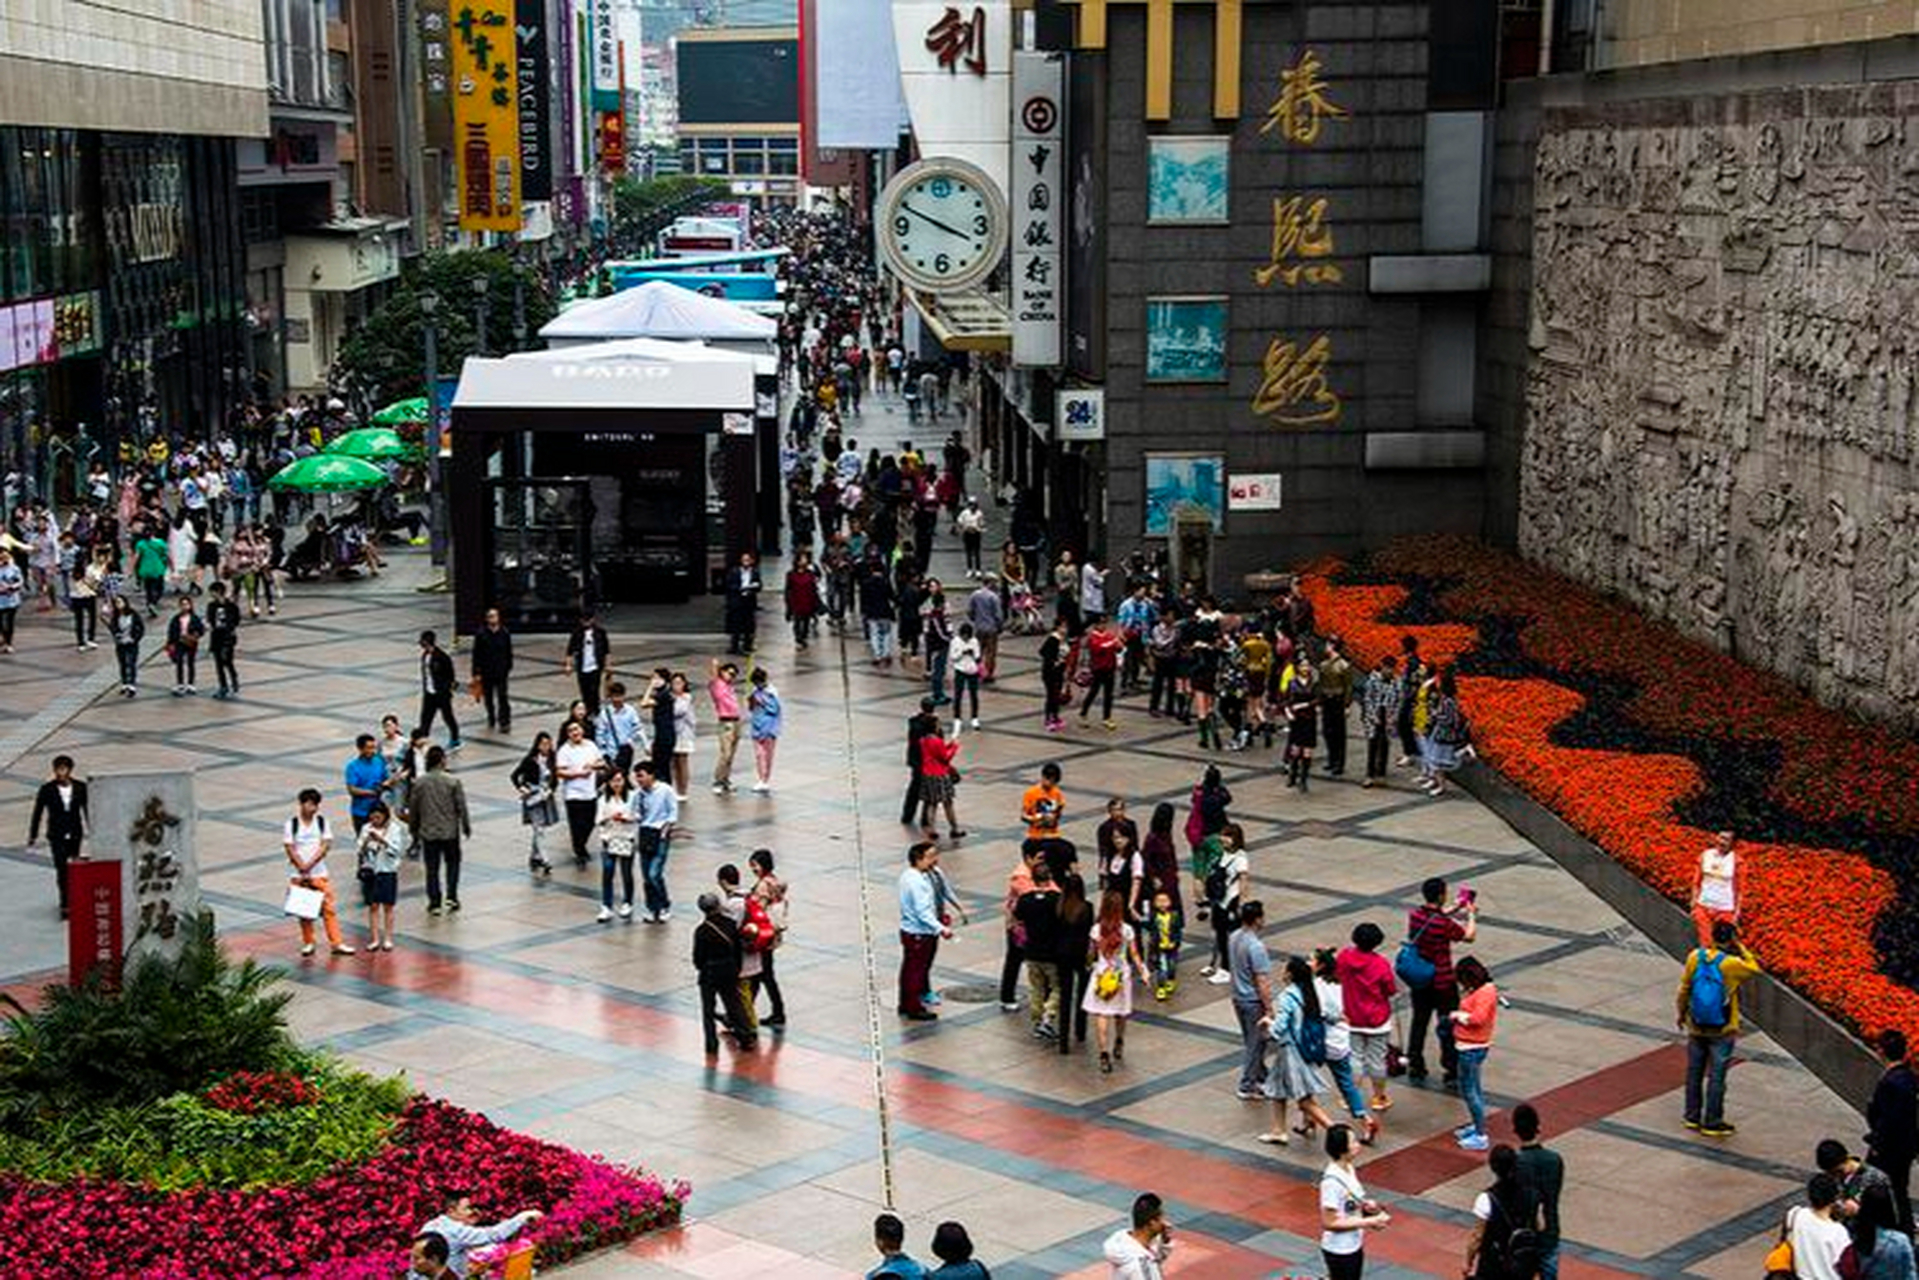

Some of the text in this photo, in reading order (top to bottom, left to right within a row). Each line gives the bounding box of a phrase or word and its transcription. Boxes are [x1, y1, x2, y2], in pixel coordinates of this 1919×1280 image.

[519, 57, 540, 171] PEACEBIRD
[1023, 144, 1052, 285] 中国银行
[895, 217, 910, 237] 9
[973, 216, 989, 236] 3
[1253, 49, 1350, 424] 春熙路
[934, 253, 950, 274] 6
[1023, 290, 1053, 300] BANK
[1030, 302, 1046, 310] OF
[1019, 312, 1056, 321] CHINA
[129, 796, 181, 939] 春熙路
